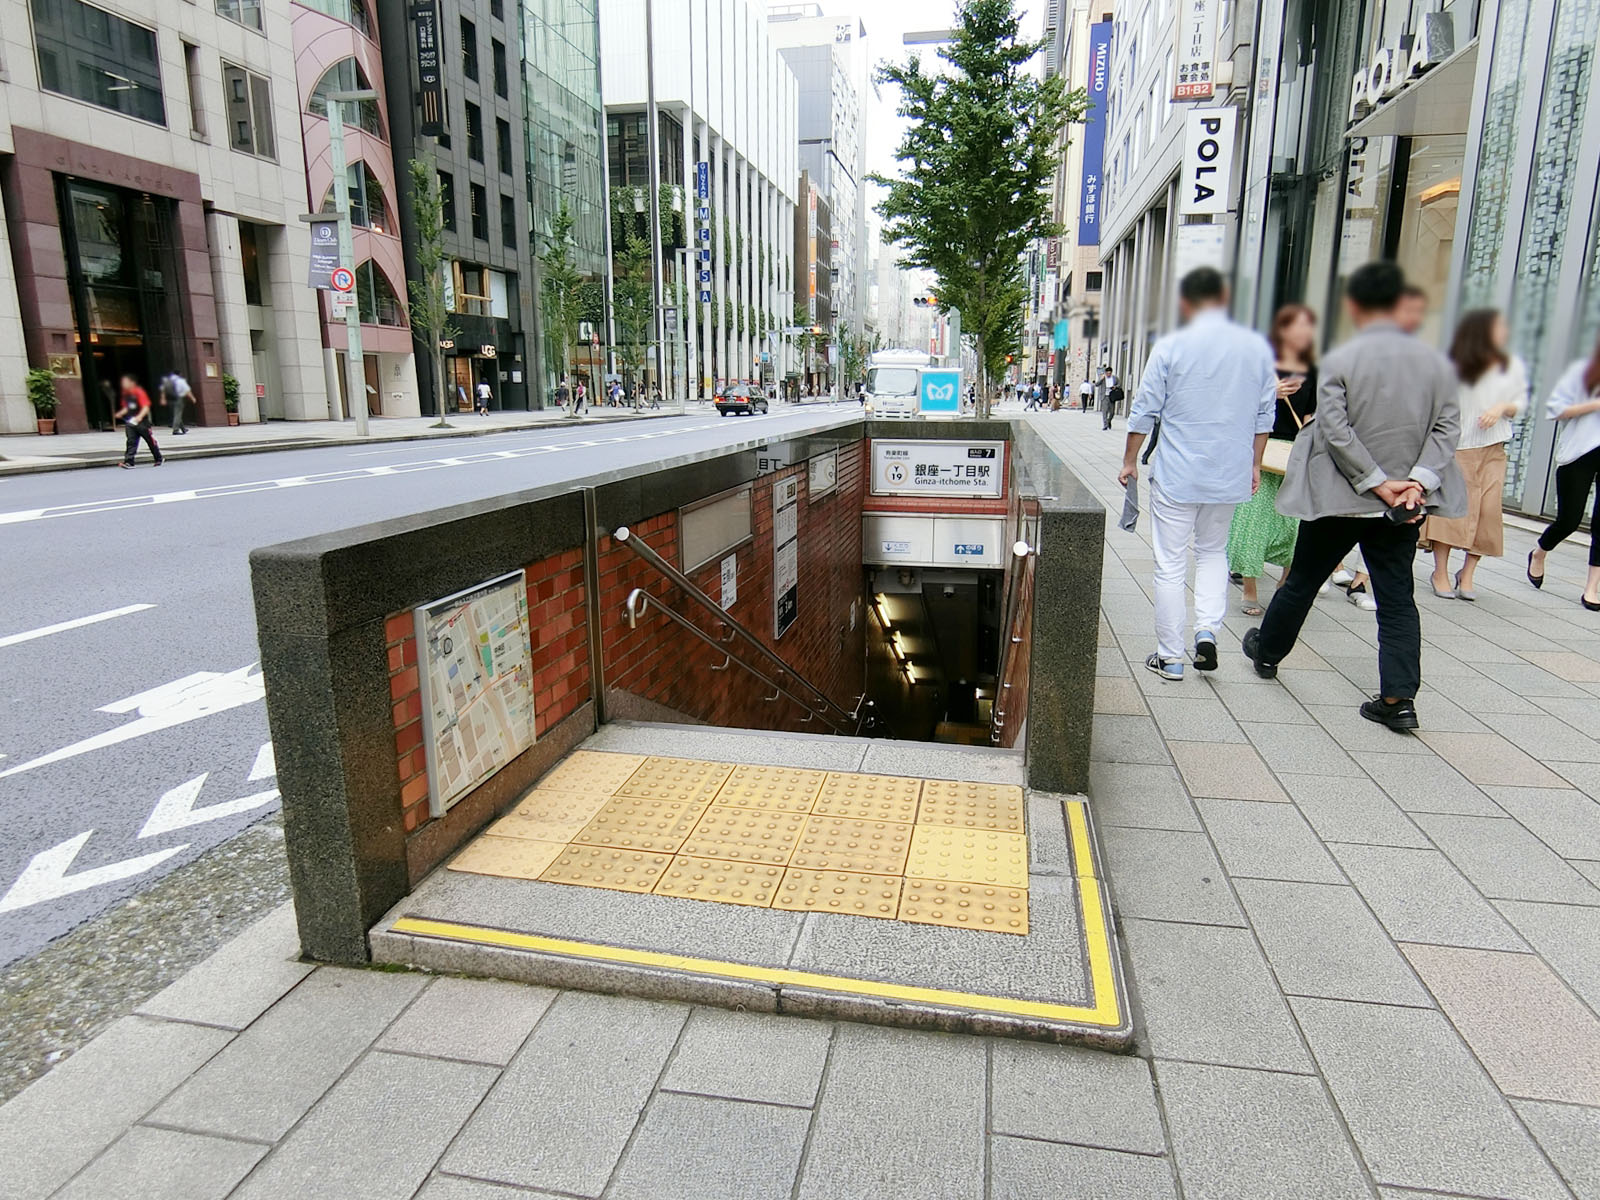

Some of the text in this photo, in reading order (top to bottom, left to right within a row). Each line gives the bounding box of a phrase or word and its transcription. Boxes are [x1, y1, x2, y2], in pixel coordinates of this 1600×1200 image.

[1094, 43, 1107, 92] MIZUHO
[1348, 13, 1430, 122] POLA
[1193, 117, 1221, 203] POLA
[1085, 174, 1096, 224] みずほ銀行
[699, 208, 710, 301] MELSA
[440, 340, 454, 349] UGG
[481, 344, 496, 357] UGG
[985, 449, 992, 458] 7
[914, 464, 990, 477] 銀座一丁目駅
[914, 477, 971, 486] Ginza-itchome
